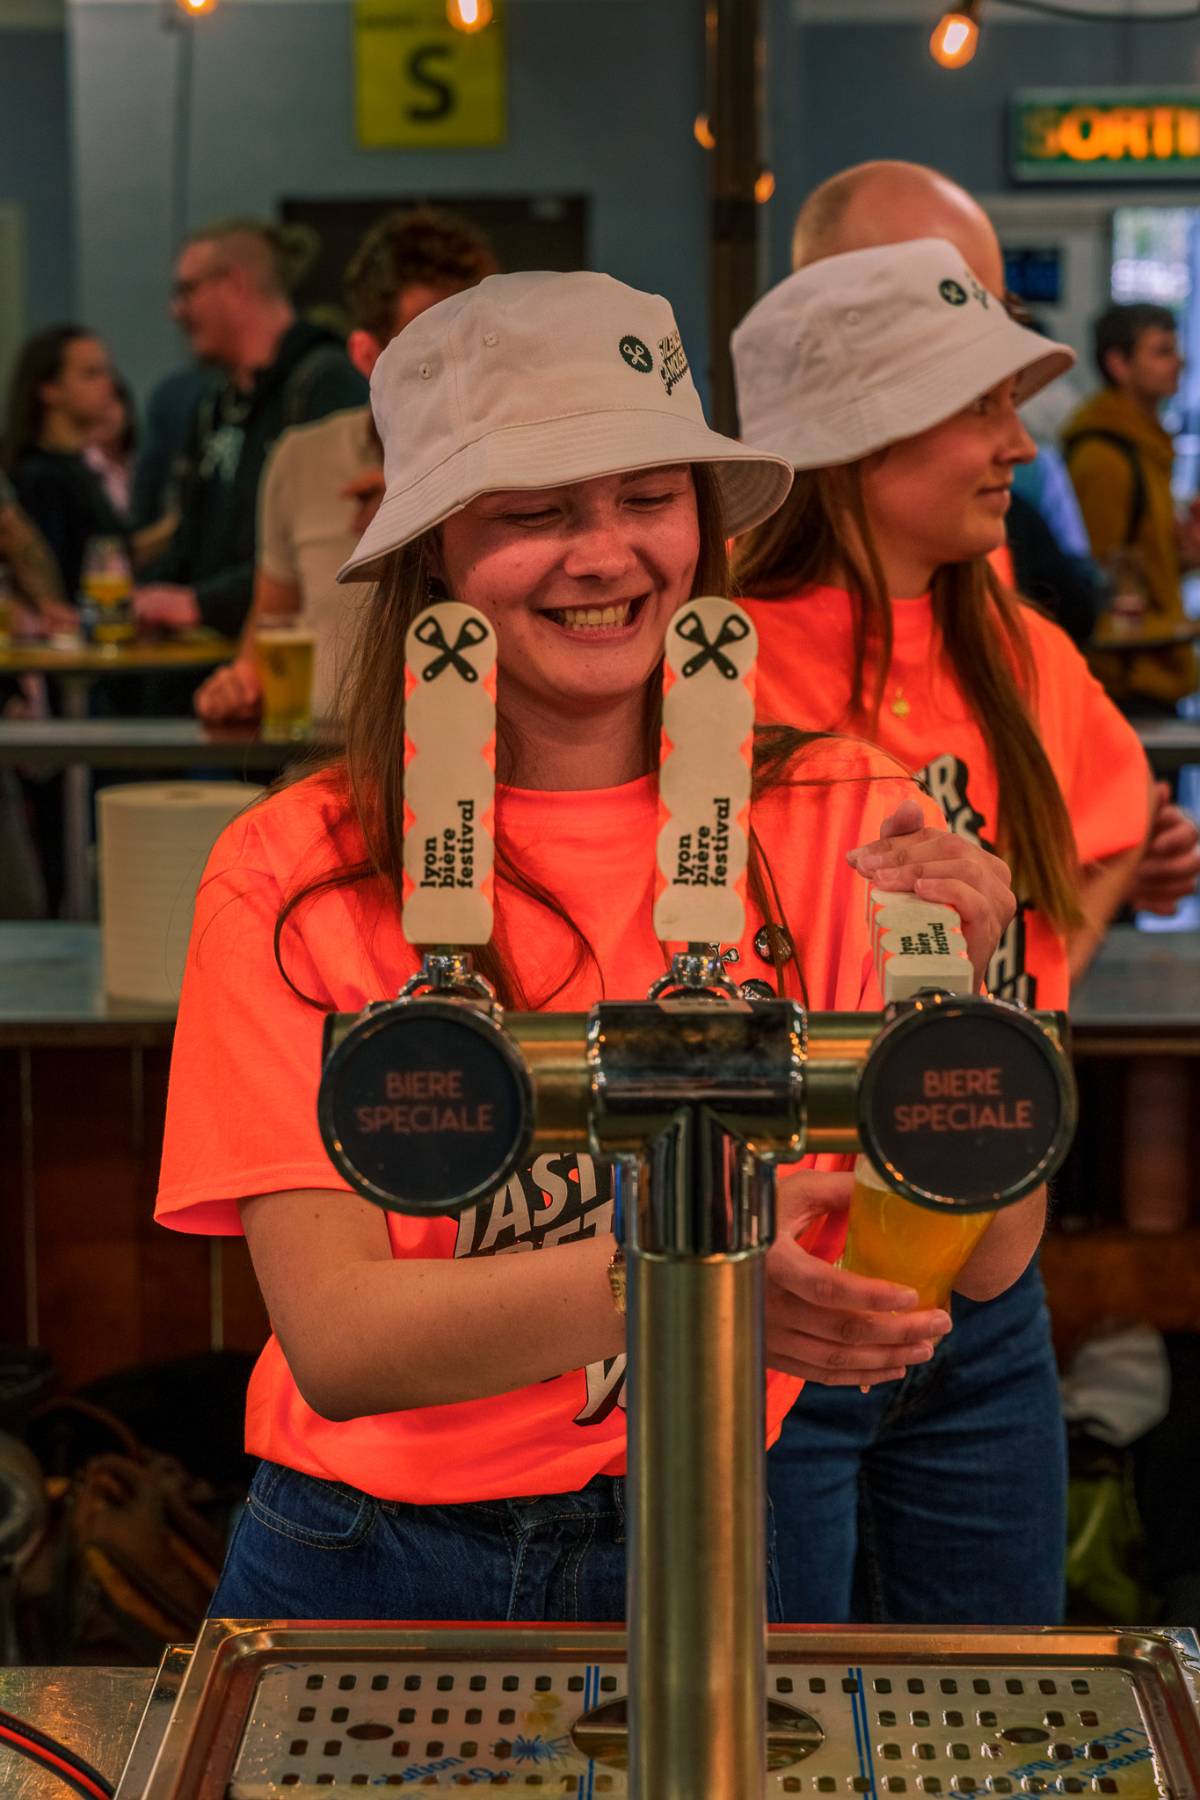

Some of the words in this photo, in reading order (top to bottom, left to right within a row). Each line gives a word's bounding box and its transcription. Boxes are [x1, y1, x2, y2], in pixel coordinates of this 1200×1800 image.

[405, 43, 457, 126] S
[420, 836, 442, 888] lyon
[438, 827, 456, 888] bière
[457, 799, 474, 888] festival
[673, 833, 695, 885] lyon
[691, 825, 711, 886] bière
[710, 797, 731, 886] festival
[385, 1070, 464, 1099] BIERE
[923, 1067, 1003, 1098] BIERE
[356, 1103, 496, 1134] SPECIALE
[894, 1099, 1034, 1132] SPECIALE
